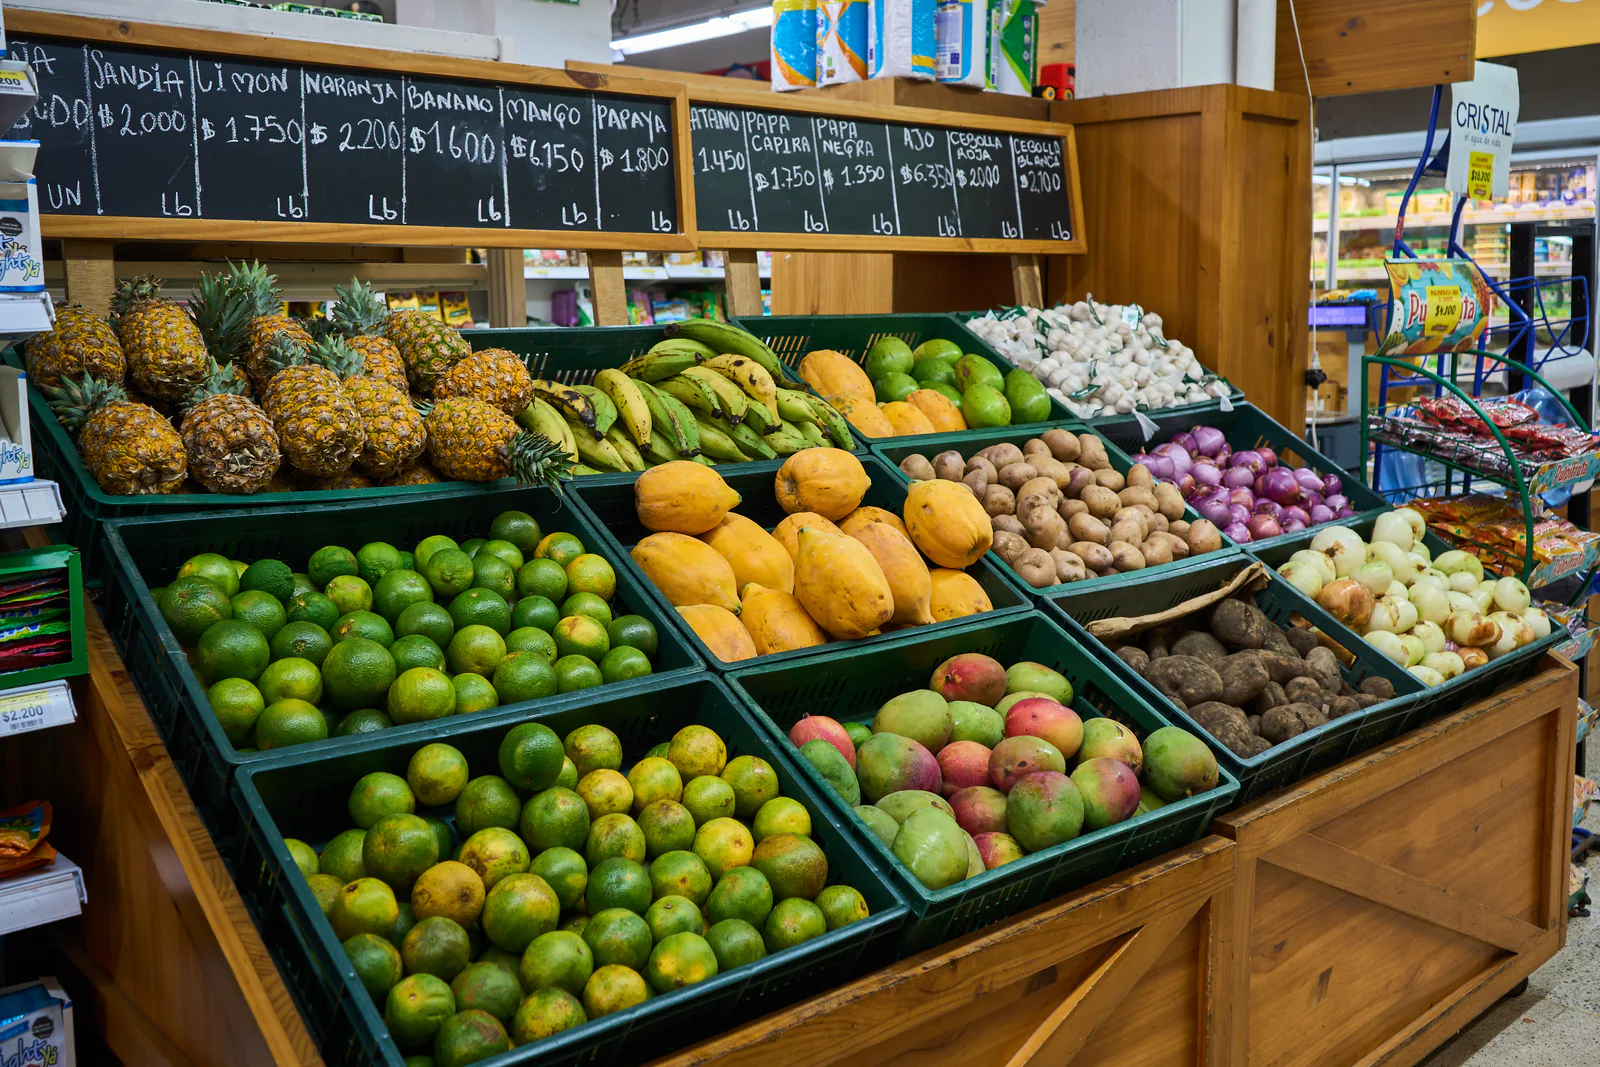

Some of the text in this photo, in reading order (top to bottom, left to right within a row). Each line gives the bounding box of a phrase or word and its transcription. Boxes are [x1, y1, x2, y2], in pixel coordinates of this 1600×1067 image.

[305, 73, 398, 104] NARANJA
[407, 85, 493, 112] BANANO
[506, 98, 581, 130] MANGO
[597, 104, 667, 143] PAPAYA
[689, 107, 740, 132] ATANO
[746, 111, 790, 134] PAPA
[1456, 101, 1512, 137] CRISTAL
[226, 115, 302, 144] 1.750
[816, 118, 858, 139] PAPA
[903, 127, 935, 151] AJO
[951, 131, 1003, 149] CEBOLLA
[752, 135, 811, 154] CAPIRA
[823, 139, 874, 158] NEGRA
[957, 148, 992, 162] ROJA
[1013, 138, 1061, 156] CEBOLLA
[620, 147, 669, 173] 1.800
[699, 147, 745, 172] 1.450
[1018, 155, 1061, 169] BLANCA
[841, 165, 885, 186] 1.350
[48, 180, 82, 209] UN
[2, 705, 44, 723] $2.200
